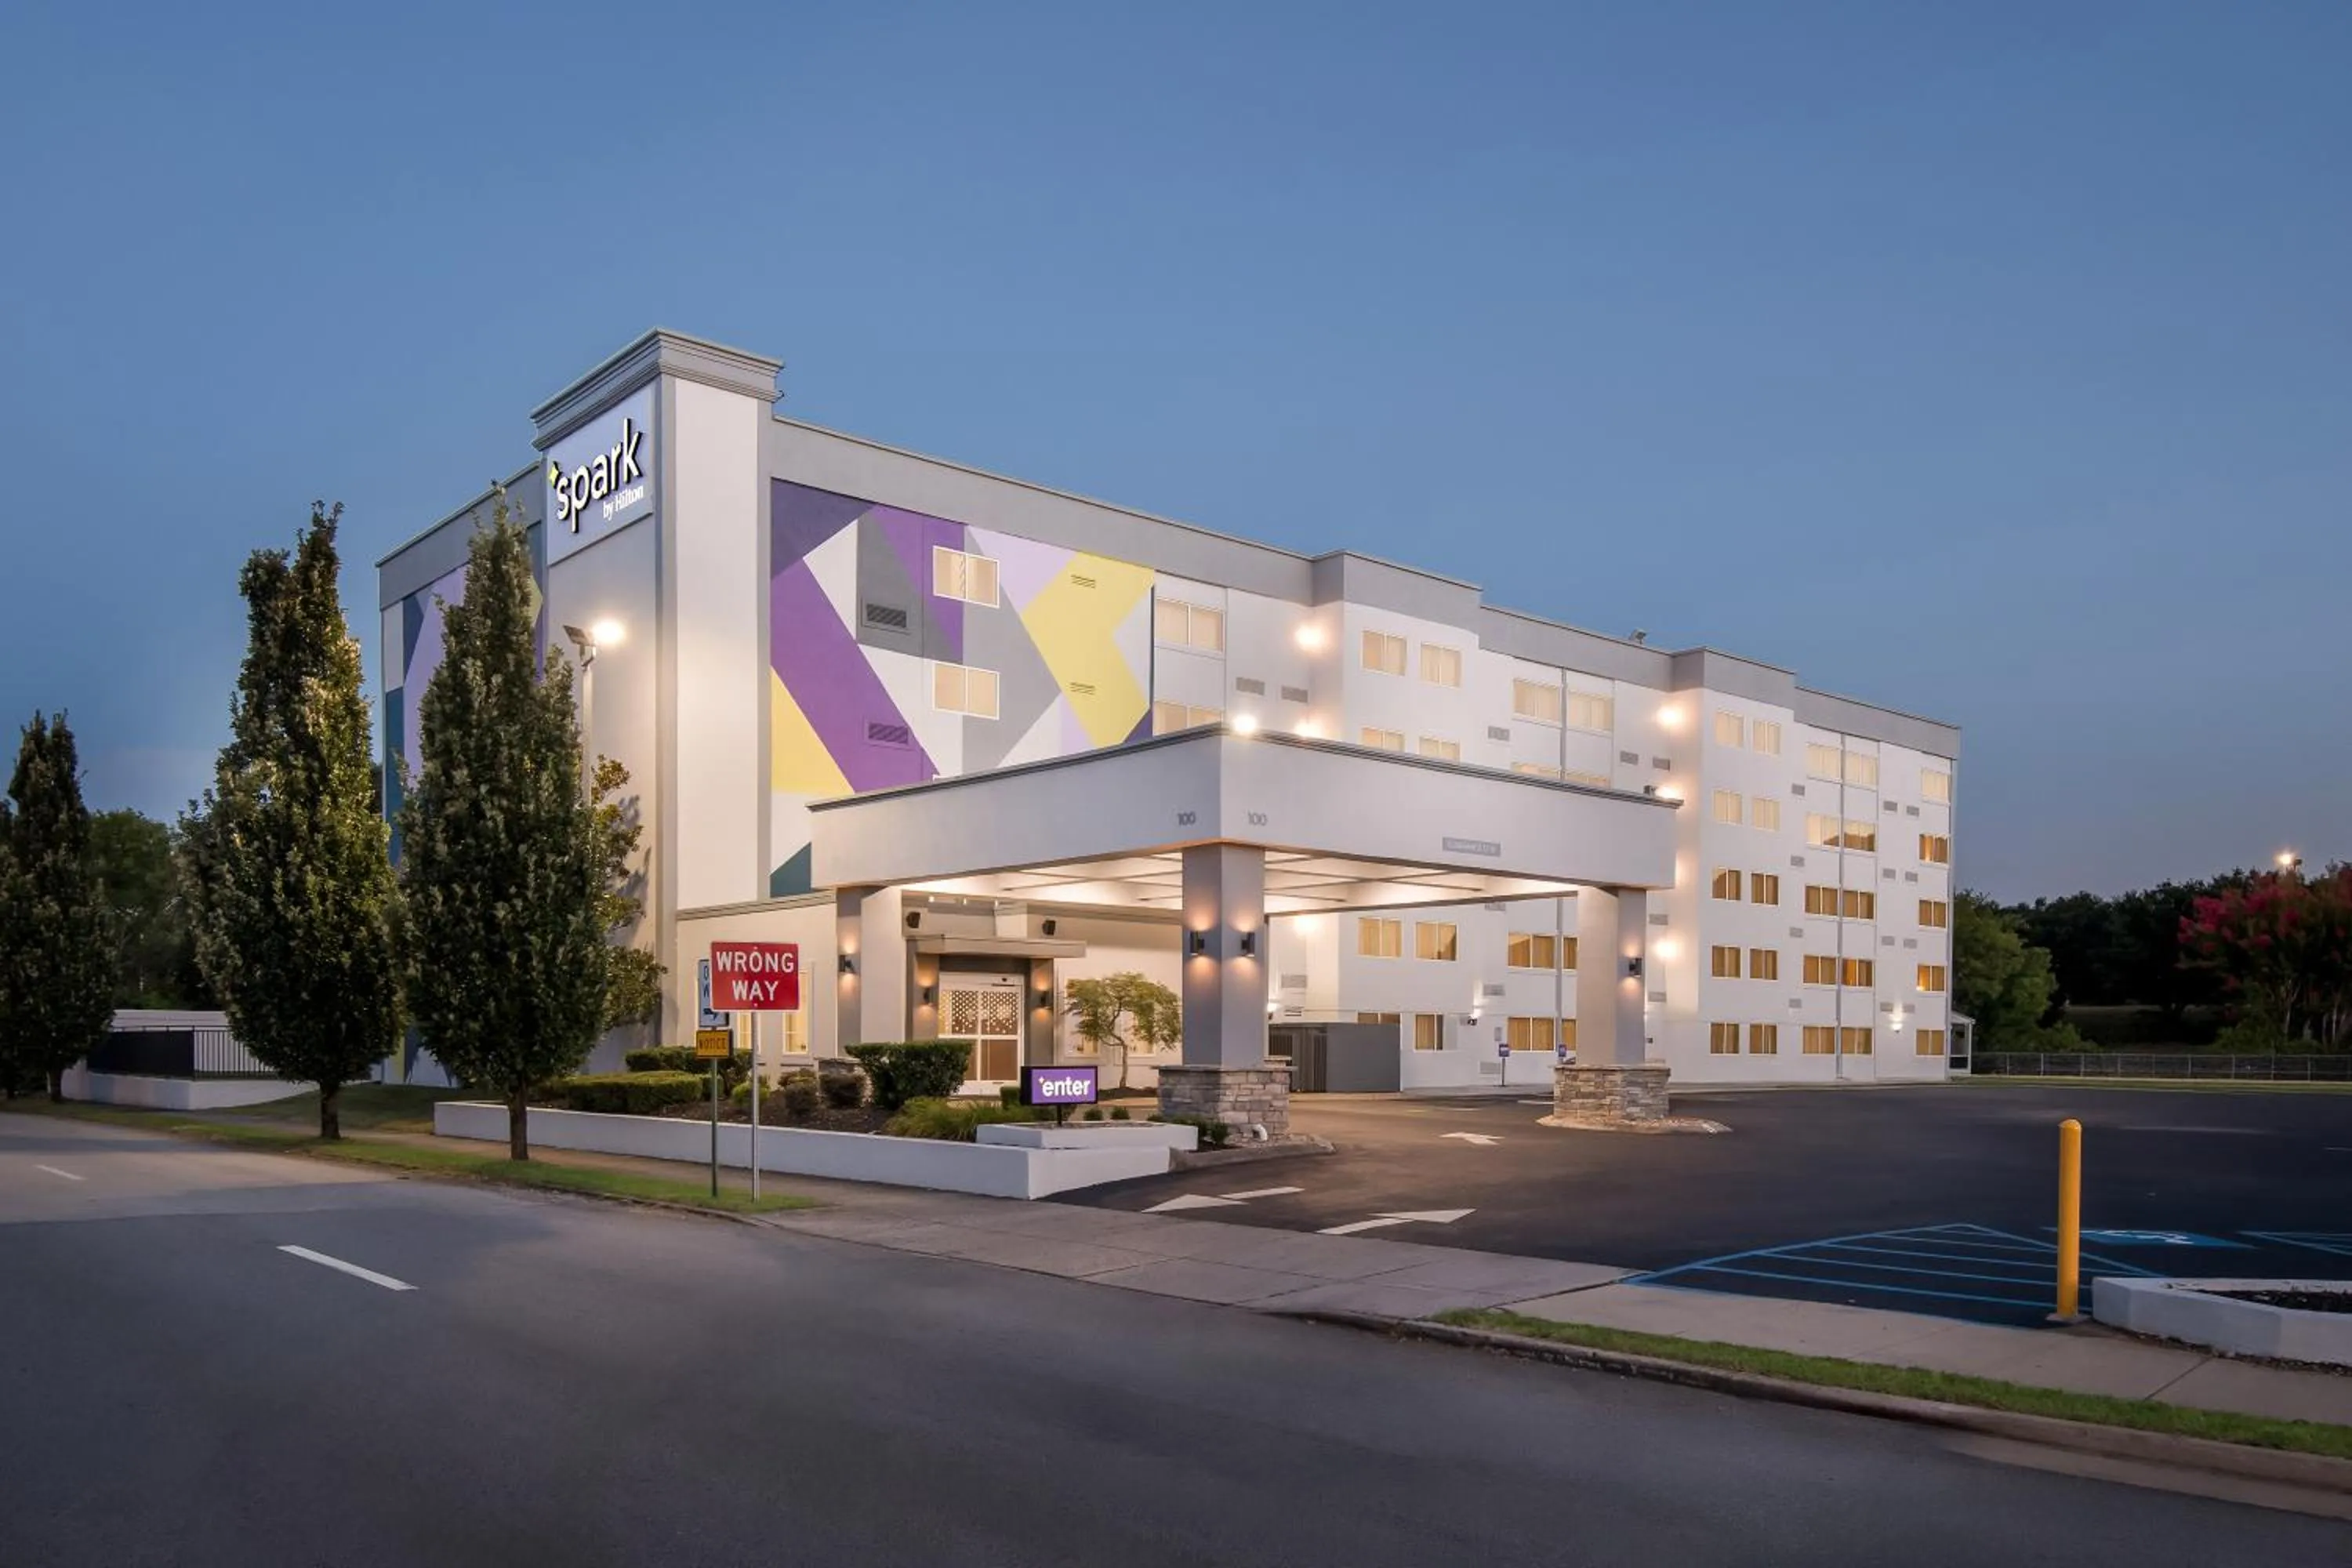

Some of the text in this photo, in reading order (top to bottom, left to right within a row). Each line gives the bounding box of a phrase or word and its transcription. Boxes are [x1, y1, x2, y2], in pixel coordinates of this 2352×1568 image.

[556, 418, 642, 532] spark
[603, 485, 644, 520] by Hilton
[1178, 811, 1196, 826] 100
[1247, 811, 1268, 826] 100
[716, 951, 794, 973] WRONG
[732, 980, 779, 1001] WAY
[699, 1038, 727, 1050] NOTICE
[1042, 1076, 1091, 1096] enter
